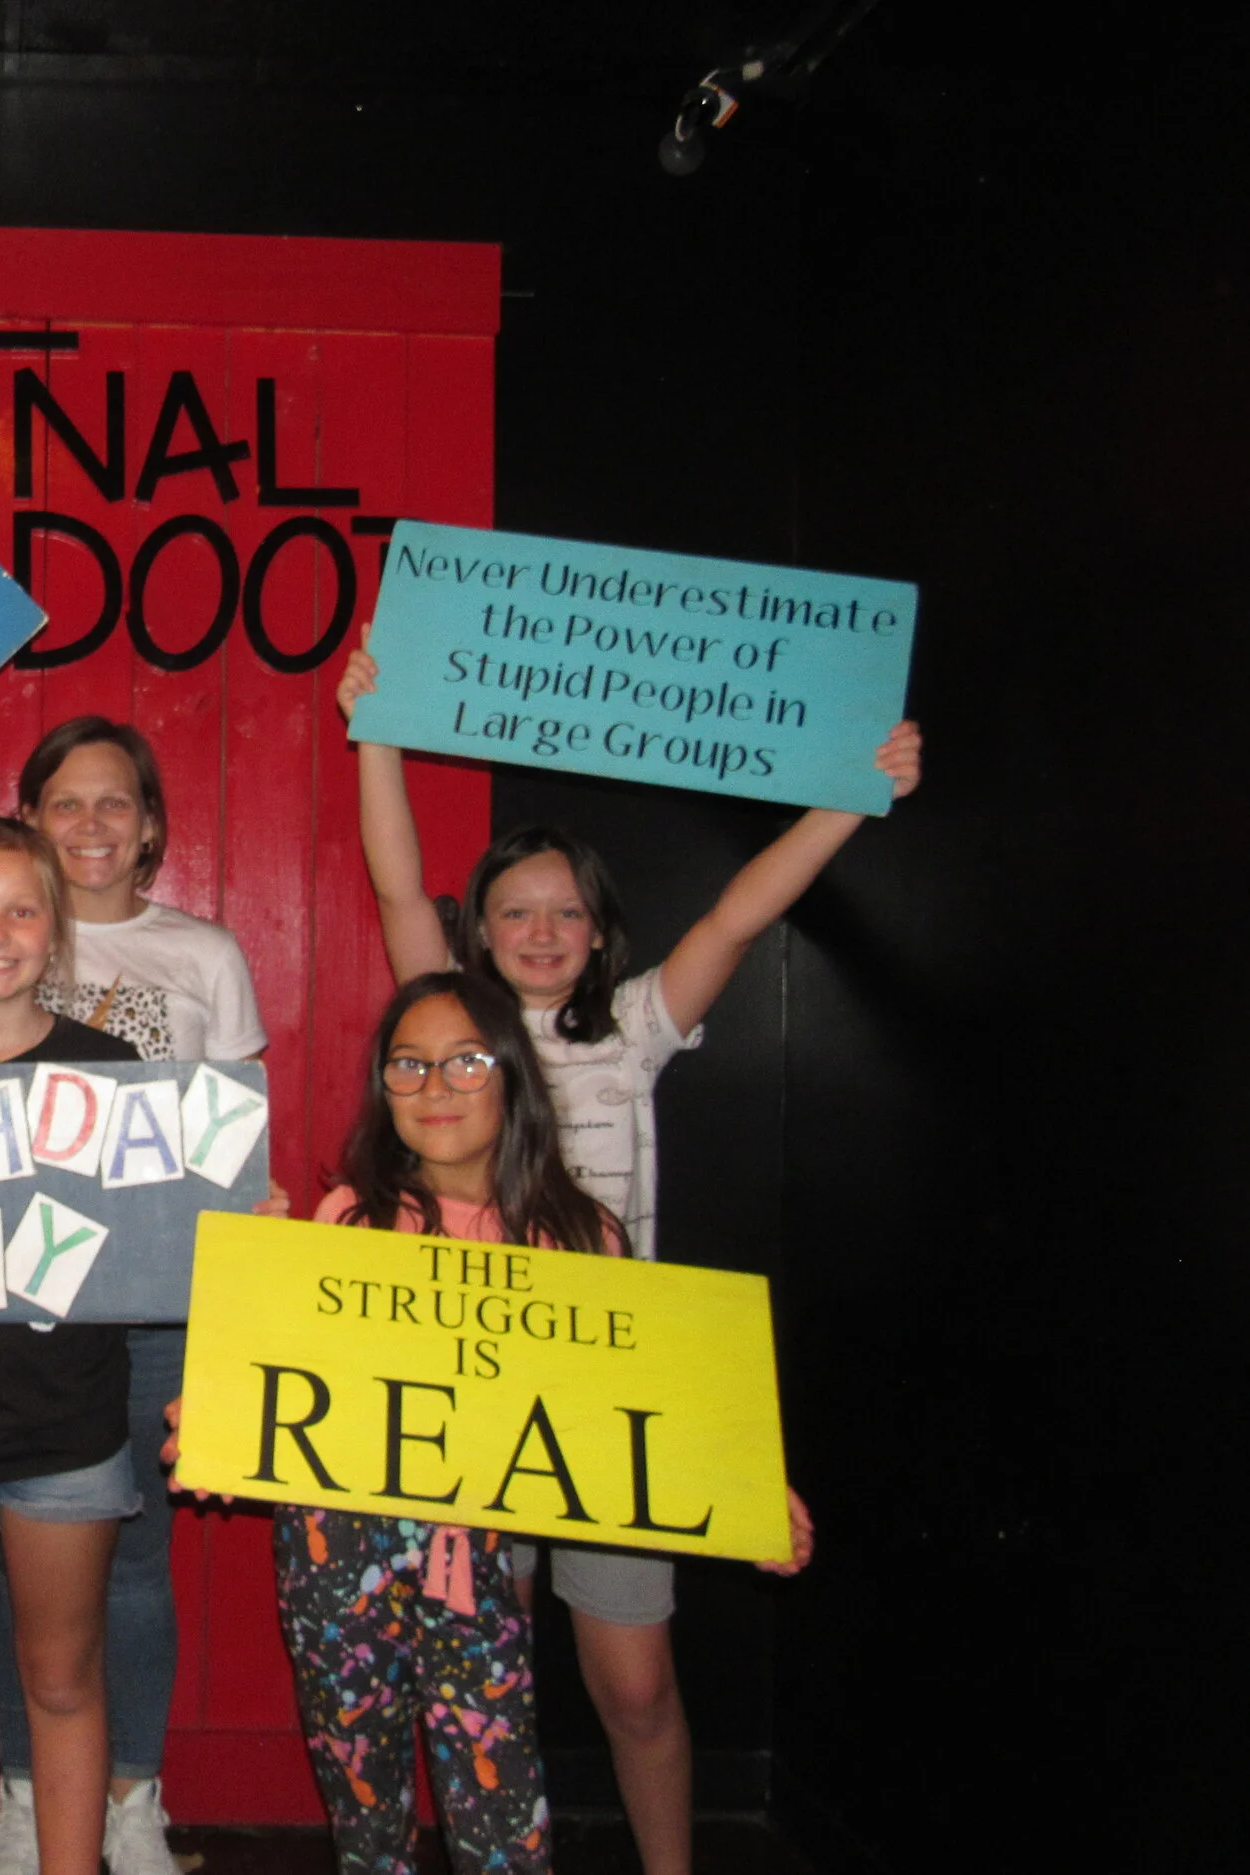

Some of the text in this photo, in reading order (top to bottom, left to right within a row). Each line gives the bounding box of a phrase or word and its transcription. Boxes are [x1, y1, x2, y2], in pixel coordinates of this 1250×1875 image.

[397, 545, 897, 637] Never Underestimate
[482, 603, 788, 672] the Power of
[444, 649, 806, 727] Stupid People in
[452, 701, 776, 780] Large Groups
[420, 1244, 534, 1293] THE
[316, 1275, 637, 1350] STRUGGLE
[454, 1337, 501, 1379] IS
[243, 1362, 714, 1538] REAL
